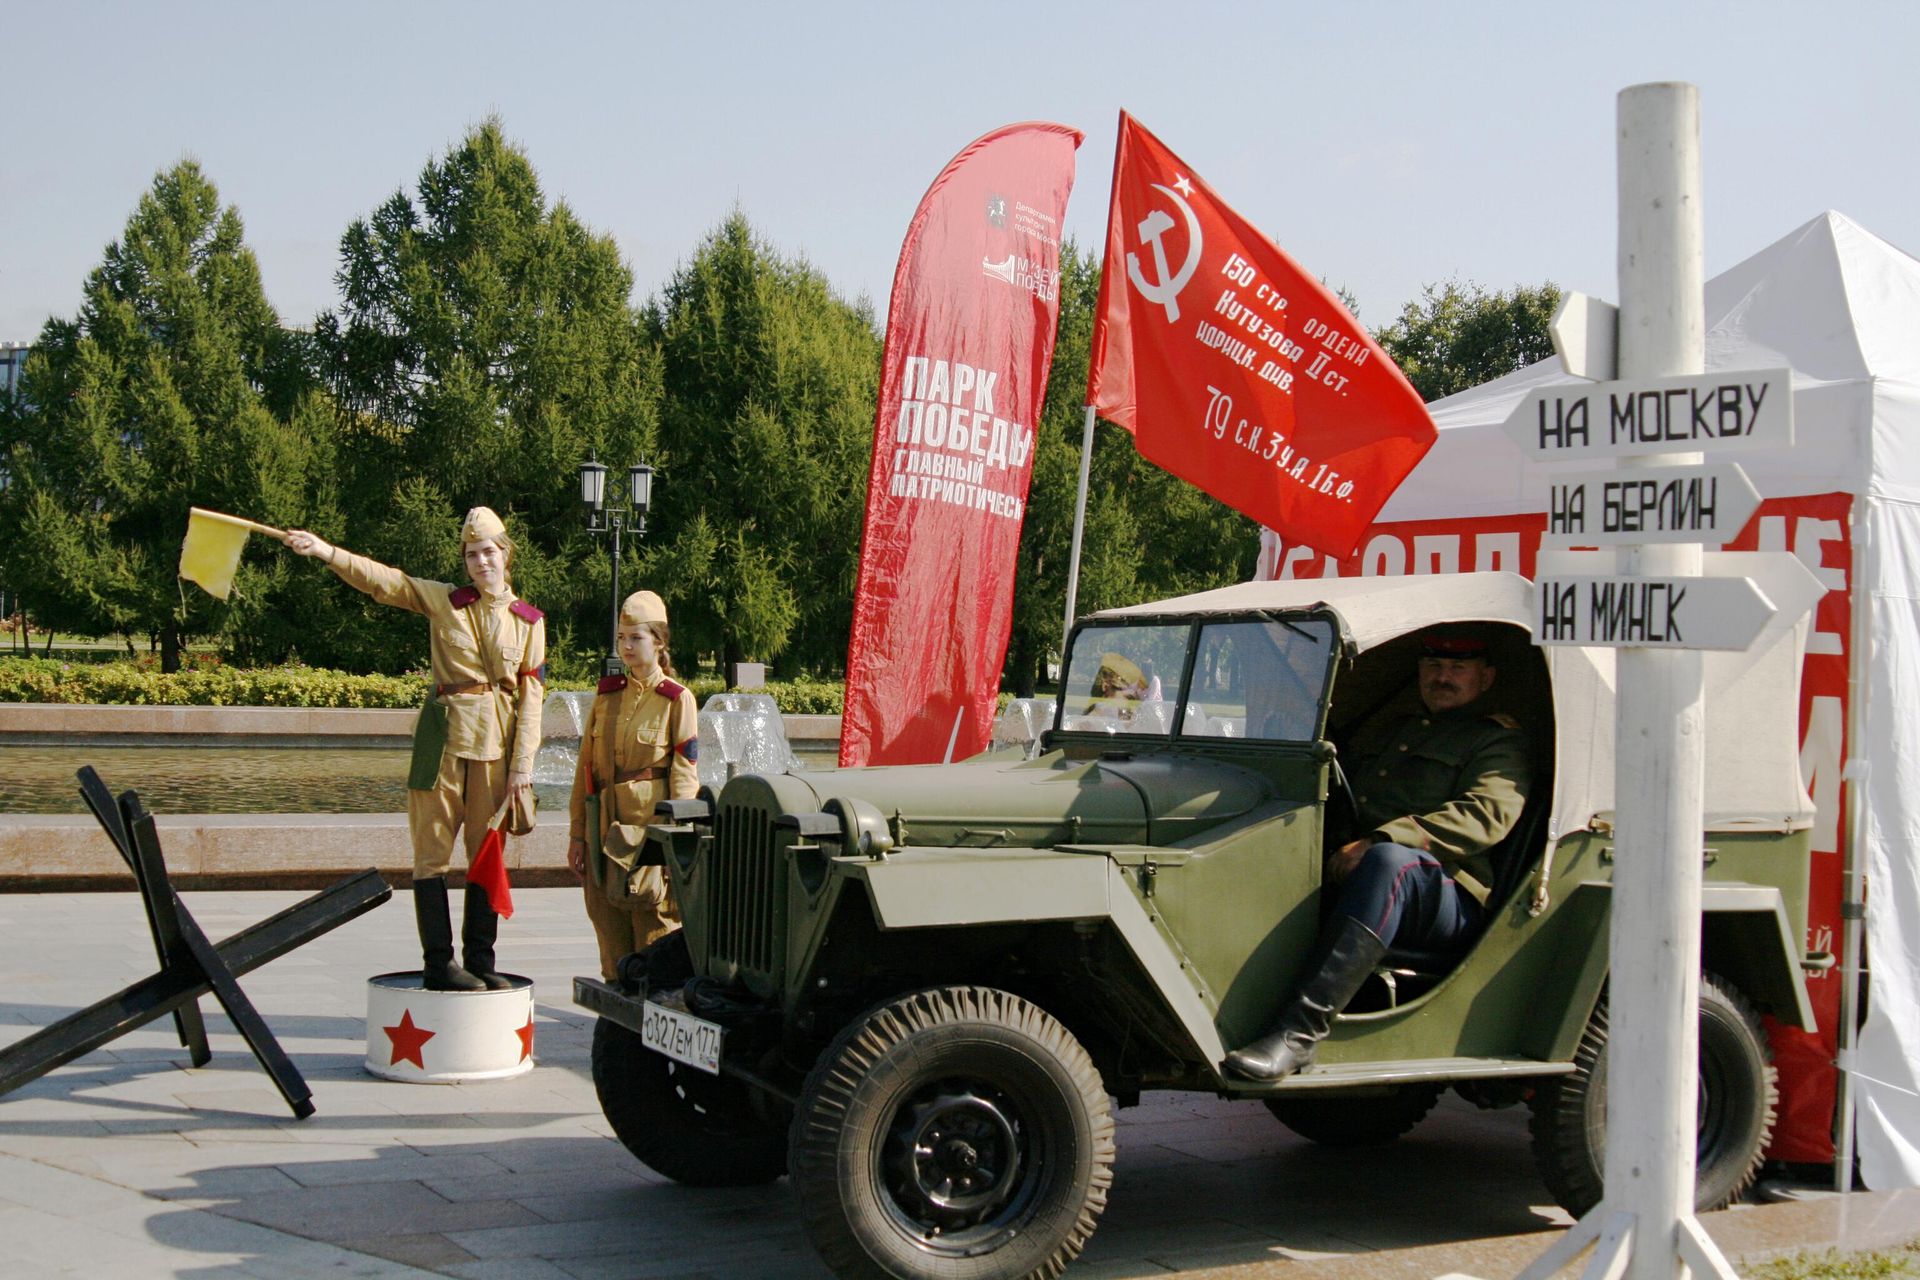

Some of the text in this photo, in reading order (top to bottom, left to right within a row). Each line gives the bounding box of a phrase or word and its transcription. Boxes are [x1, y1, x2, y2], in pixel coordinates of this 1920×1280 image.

[1221, 253, 1257, 288] 150
[902, 355, 997, 414] ПАРК
[1204, 384, 1233, 440] 79
[897, 400, 1032, 471] ПОБЕДЫ
[1539, 382, 1770, 449] НА МОСКВУ
[894, 448, 984, 485] ГЛАВНЫЙ
[1551, 476, 1718, 535] НА БЕРЛИН
[1541, 582, 1577, 641] НА
[1590, 582, 1687, 642] МИНСК
